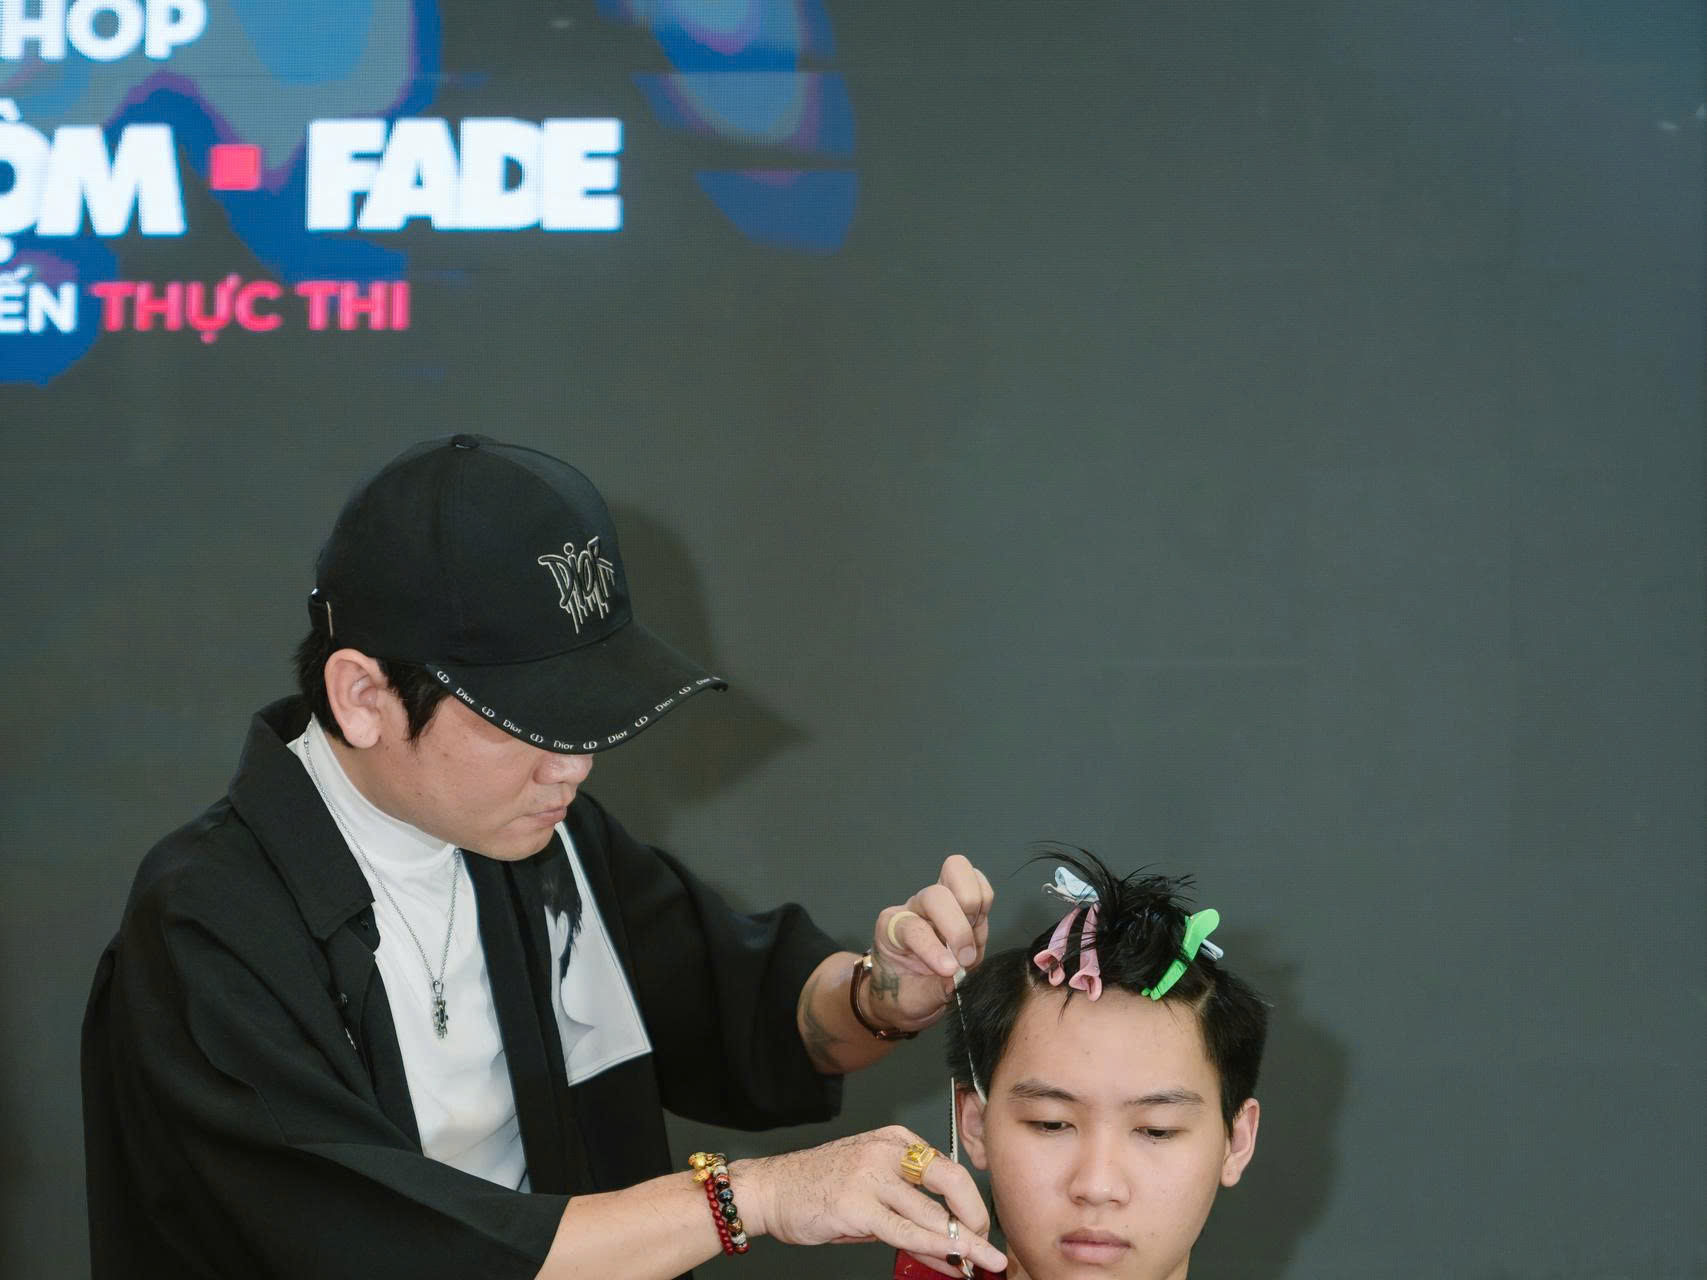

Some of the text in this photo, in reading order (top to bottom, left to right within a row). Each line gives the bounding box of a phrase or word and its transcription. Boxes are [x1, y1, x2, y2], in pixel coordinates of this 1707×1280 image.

[0, 0, 208, 61] HOP
[306, 117, 623, 231] FADE
[91, 274, 283, 343] THỰC
[296, 281, 411, 331] THI
[455, 687, 476, 705] Dior
[502, 719, 523, 734] Dior
[553, 740, 574, 750] Dior
[607, 730, 628, 744] Dior
[654, 698, 674, 712] Dior
